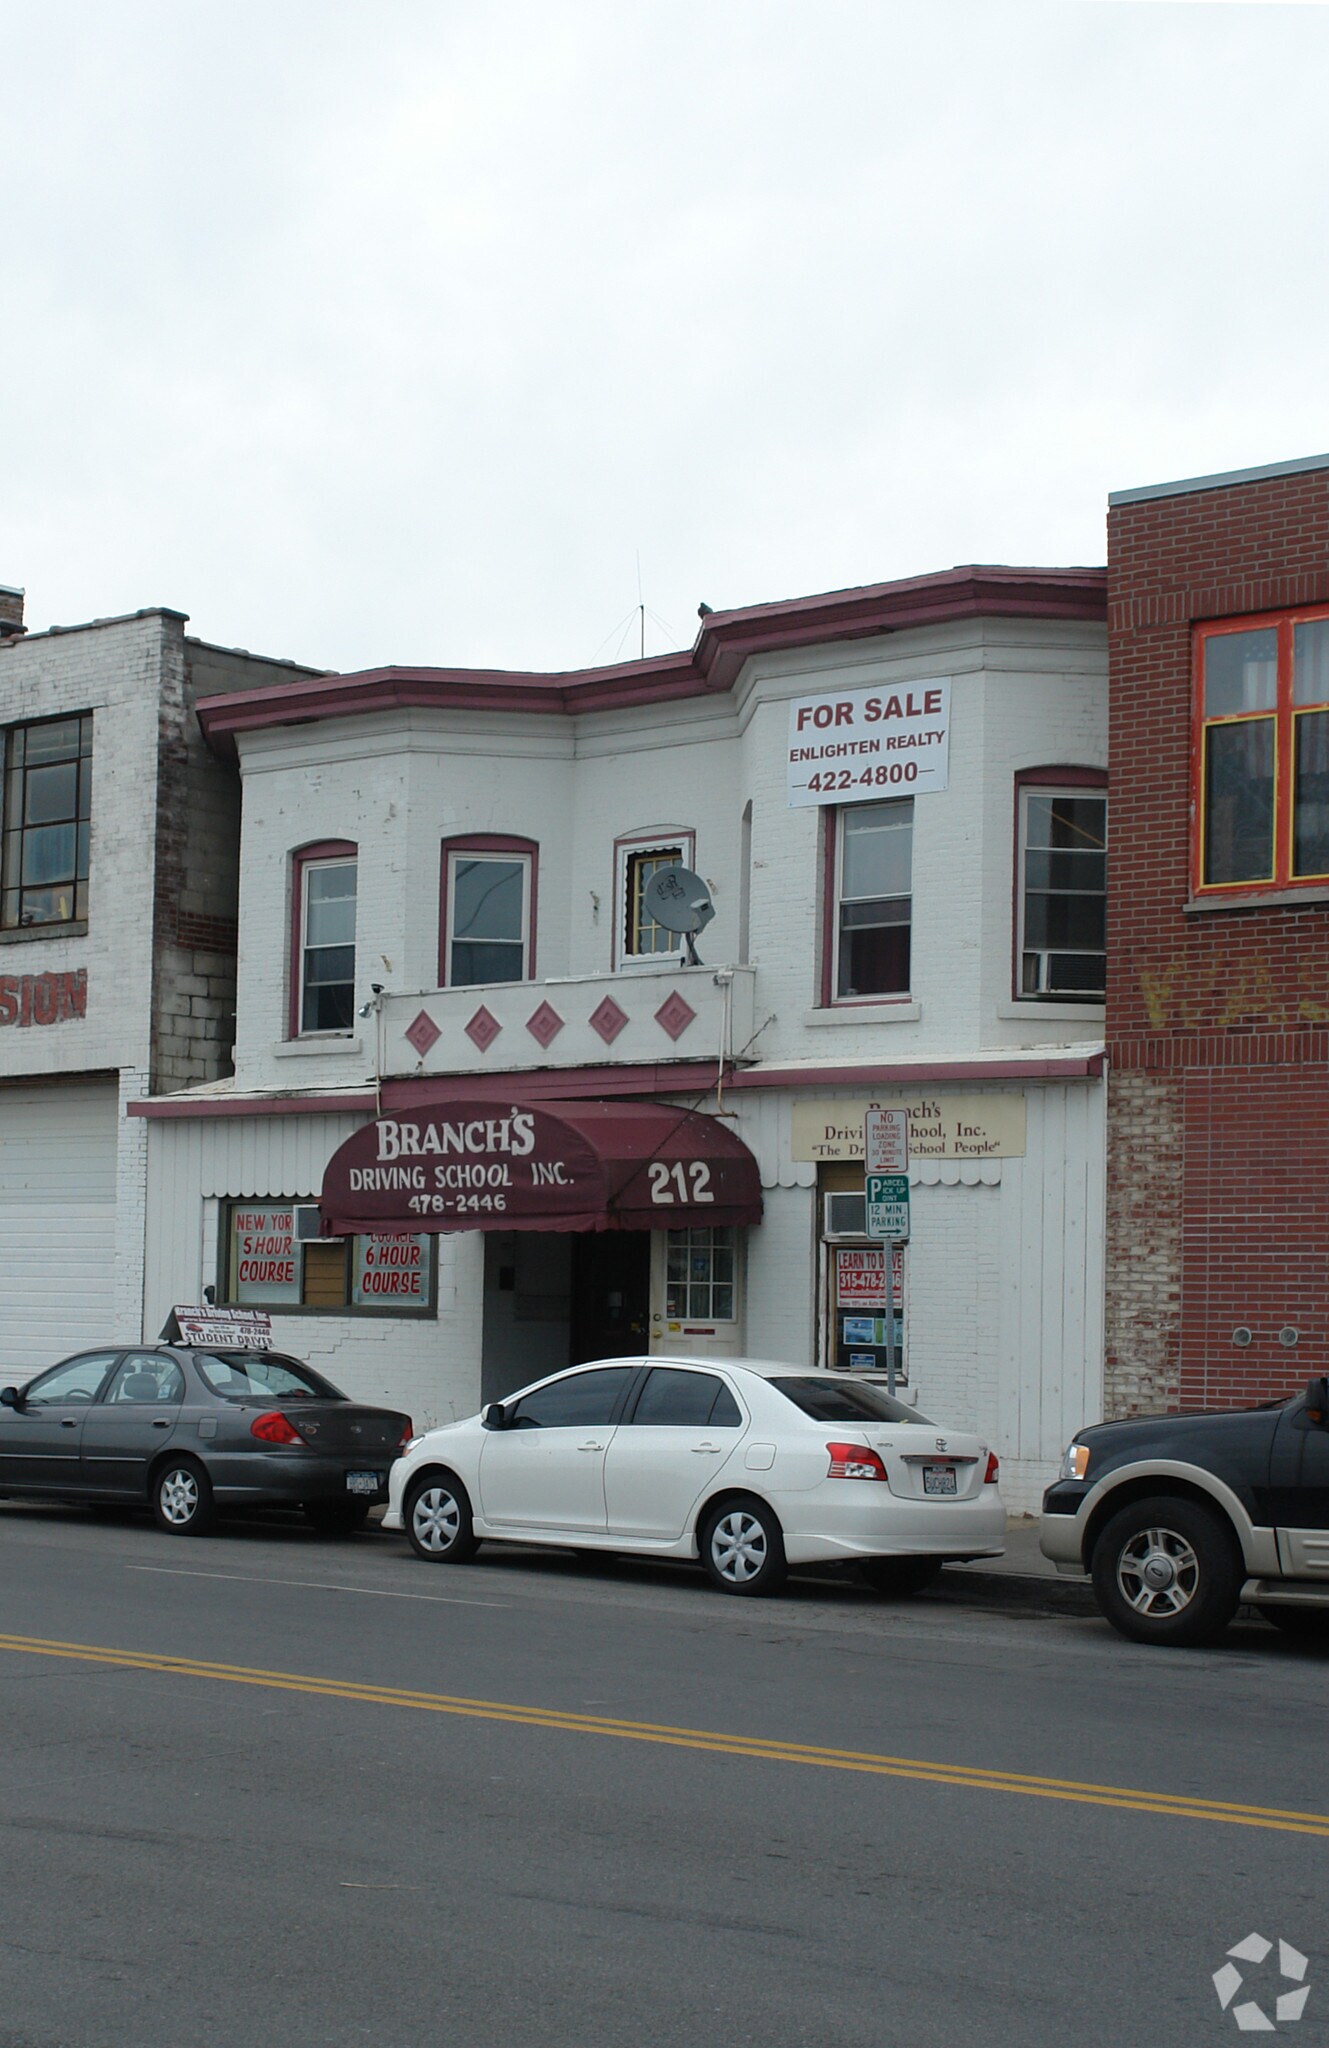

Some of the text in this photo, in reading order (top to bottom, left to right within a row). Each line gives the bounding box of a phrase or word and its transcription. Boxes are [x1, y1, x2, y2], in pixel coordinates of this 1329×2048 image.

[797, 689, 942, 731] FOR SALE
[789, 730, 945, 762] ENLIGHTEN REALTY
[808, 761, 918, 792] 422-4800
[0, 967, 88, 1028] SION
[880, 1113, 894, 1123] NO
[375, 1106, 535, 1162] BRANCH'S
[824, 1122, 987, 1140] Drivi hool, Inc.
[872, 1124, 901, 1132] PARKING
[872, 1132, 901, 1140] LOADING
[878, 1140, 896, 1148] ZONE
[881, 1148, 902, 1156] MINUTE
[880, 1156, 895, 1164] LIMIT
[348, 1162, 575, 1191] DRIVING SCHOOL INC.
[648, 1162, 715, 1204] 212
[882, 1179, 905, 1187] ARCEL
[870, 1179, 881, 1202] P
[407, 1194, 507, 1214] 478-2446
[871, 1204, 880, 1215] 12
[236, 1214, 293, 1231] NEW YOR
[871, 1216, 906, 1227] PARKING
[243, 1236, 292, 1255] 5 HOUR
[366, 1246, 421, 1265] 6 HOUR
[839, 1252, 902, 1270] LEARN TO DVE
[239, 1260, 295, 1282] COURSE
[362, 1271, 421, 1294] COURSE
[185, 1332, 274, 1347] STUDENT DRIVER
